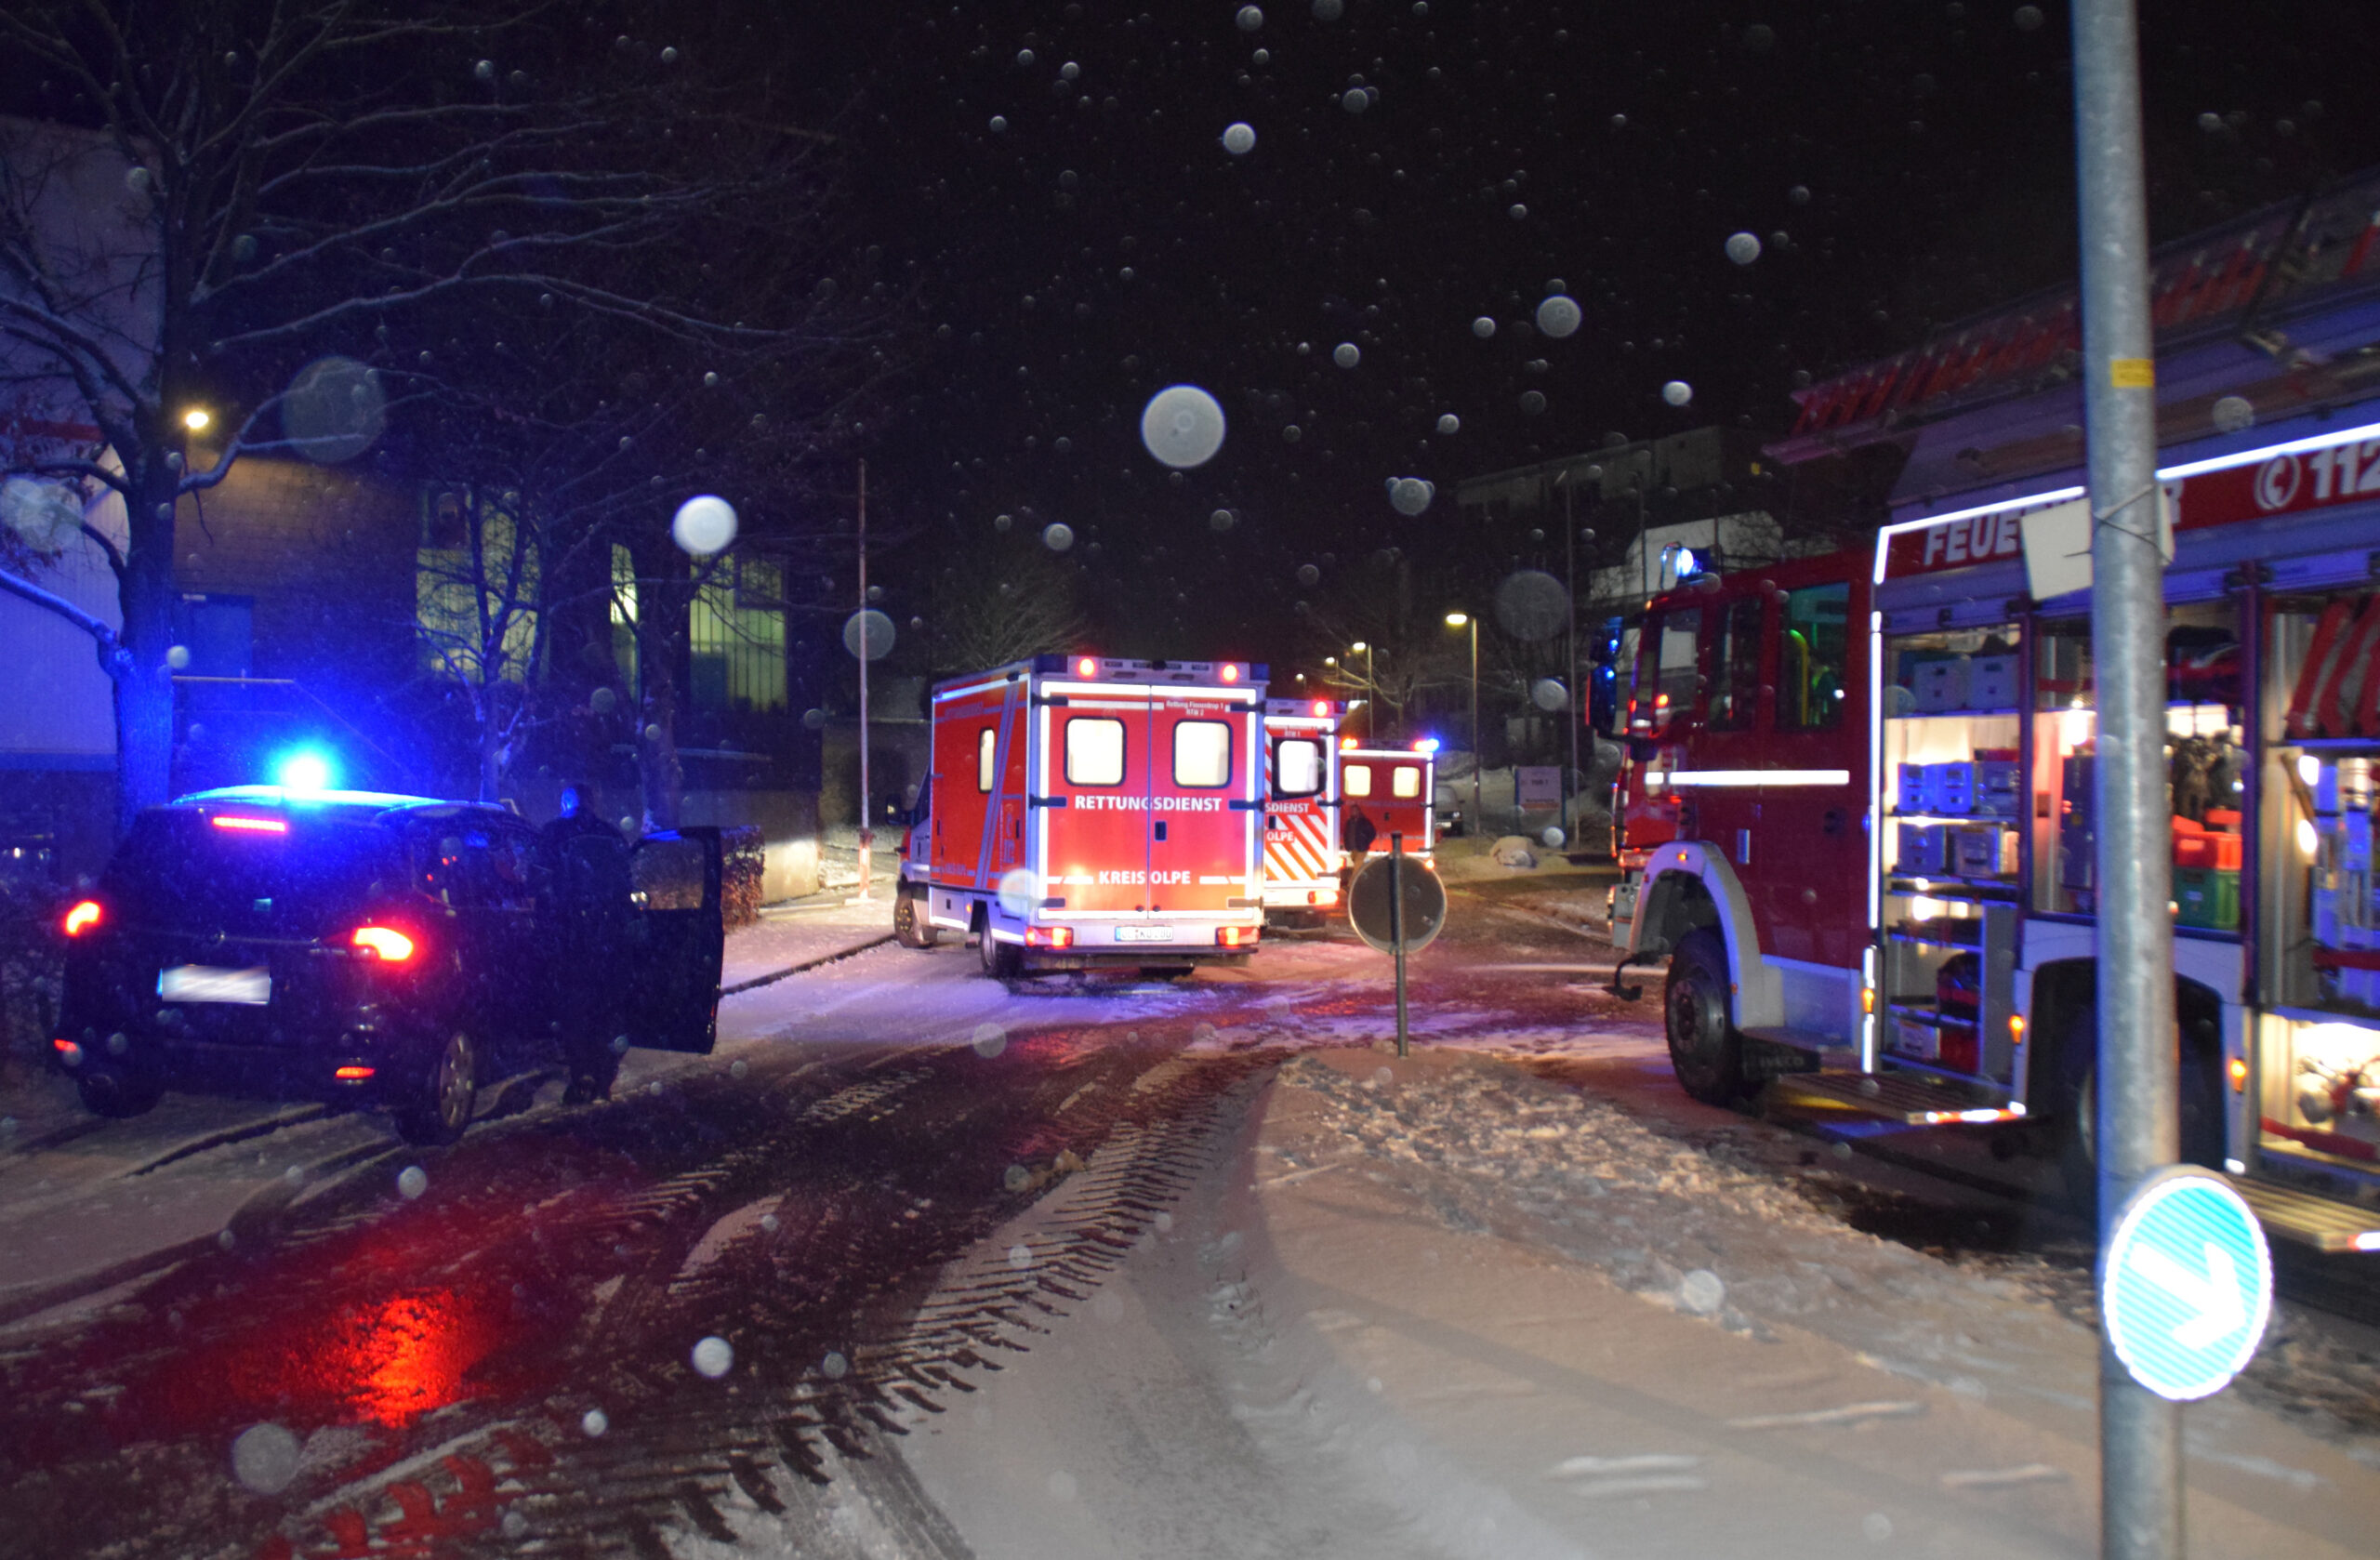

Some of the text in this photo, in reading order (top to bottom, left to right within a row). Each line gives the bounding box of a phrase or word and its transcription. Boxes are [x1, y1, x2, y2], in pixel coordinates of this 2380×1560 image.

[2309, 440, 2380, 500] 112
[1075, 795, 1222, 811] RETTUNGSDIENST
[1267, 831, 1294, 842] OLPE
[1099, 870, 1191, 885] KREIS OLPE
